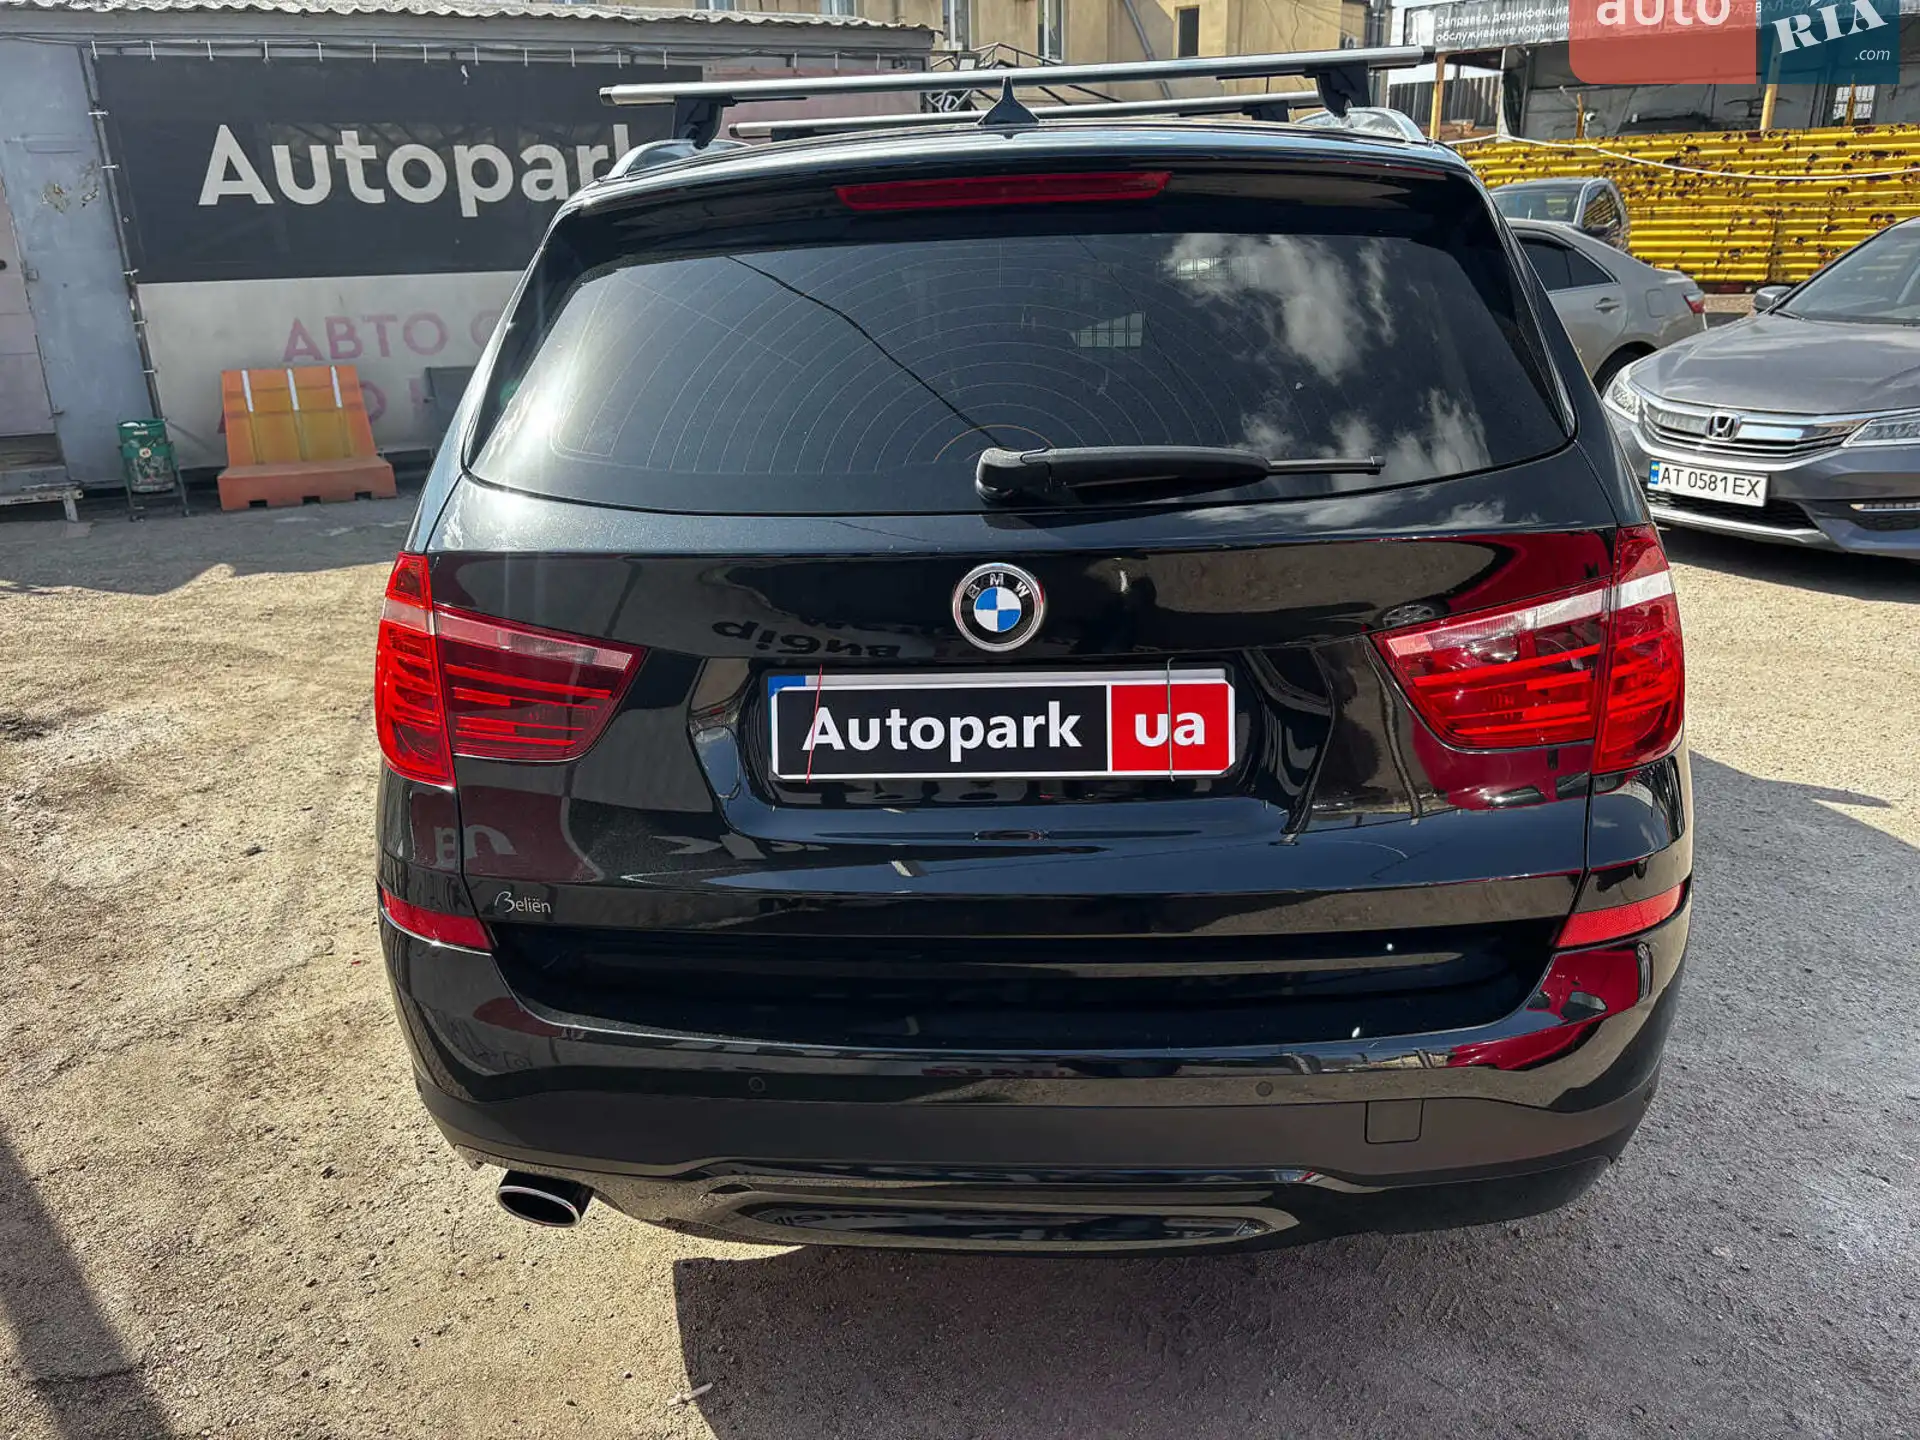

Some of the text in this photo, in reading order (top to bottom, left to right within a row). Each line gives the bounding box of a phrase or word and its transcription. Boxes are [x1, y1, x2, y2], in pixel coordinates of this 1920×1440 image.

[282, 311, 449, 363] АВТО
[1660, 466, 1762, 499] AT 0581 EX
[965, 573, 1031, 600] BMW
[802, 700, 1206, 763] Autopark ua
